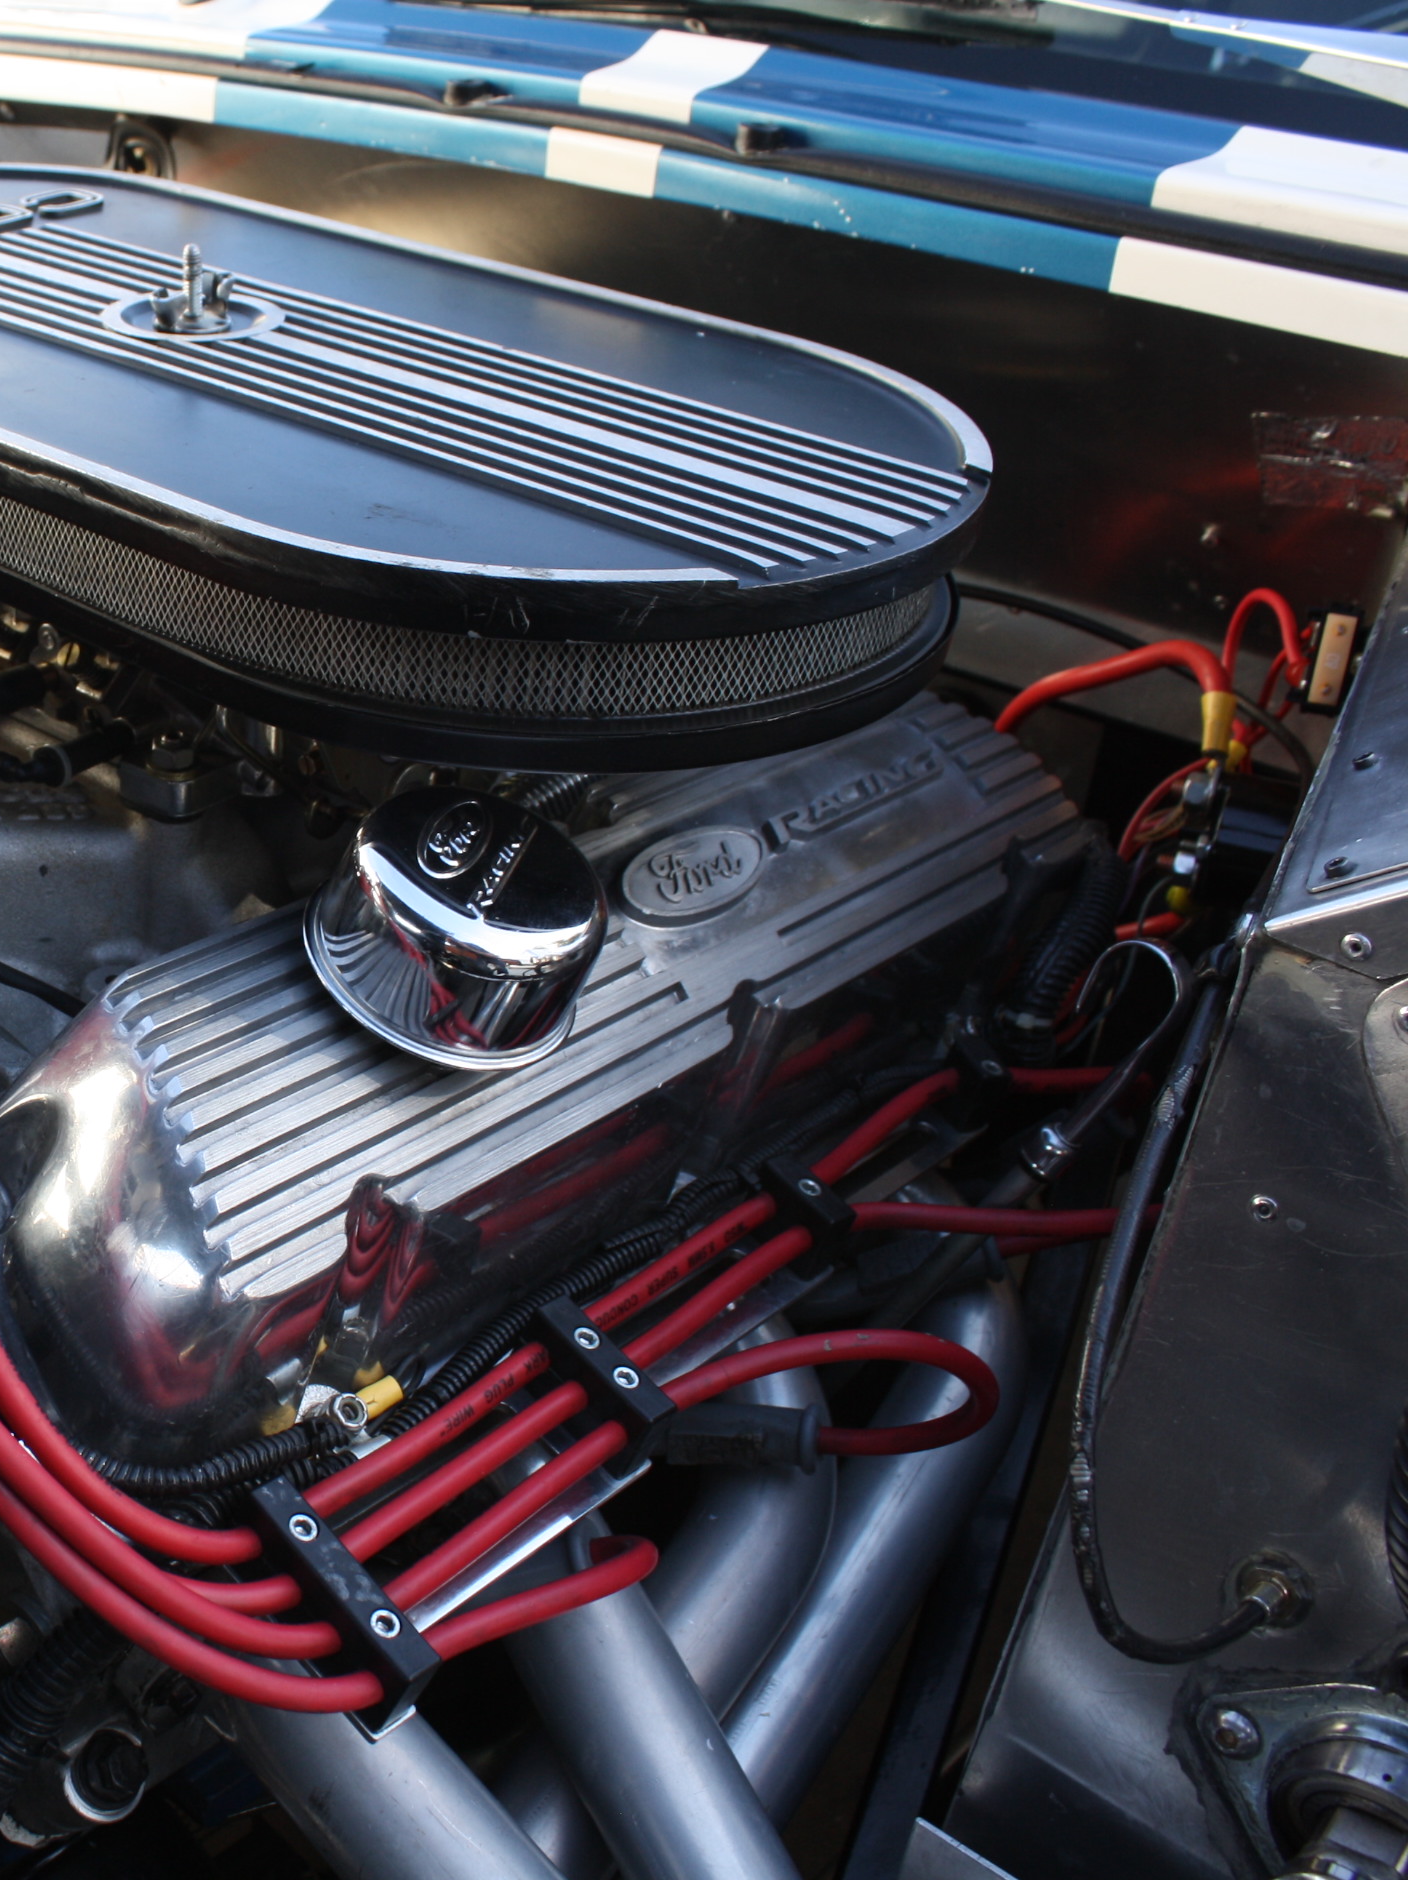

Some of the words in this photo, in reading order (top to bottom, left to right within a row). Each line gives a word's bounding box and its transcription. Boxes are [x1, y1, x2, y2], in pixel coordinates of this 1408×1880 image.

[646, 840, 742, 902] Ford
[763, 749, 943, 853] RACING
[428, 820, 480, 867] Ford
[646, 1266, 679, 1297] SUPER
[595, 1294, 639, 1328] CONDUC
[484, 1373, 515, 1404] PLUG
